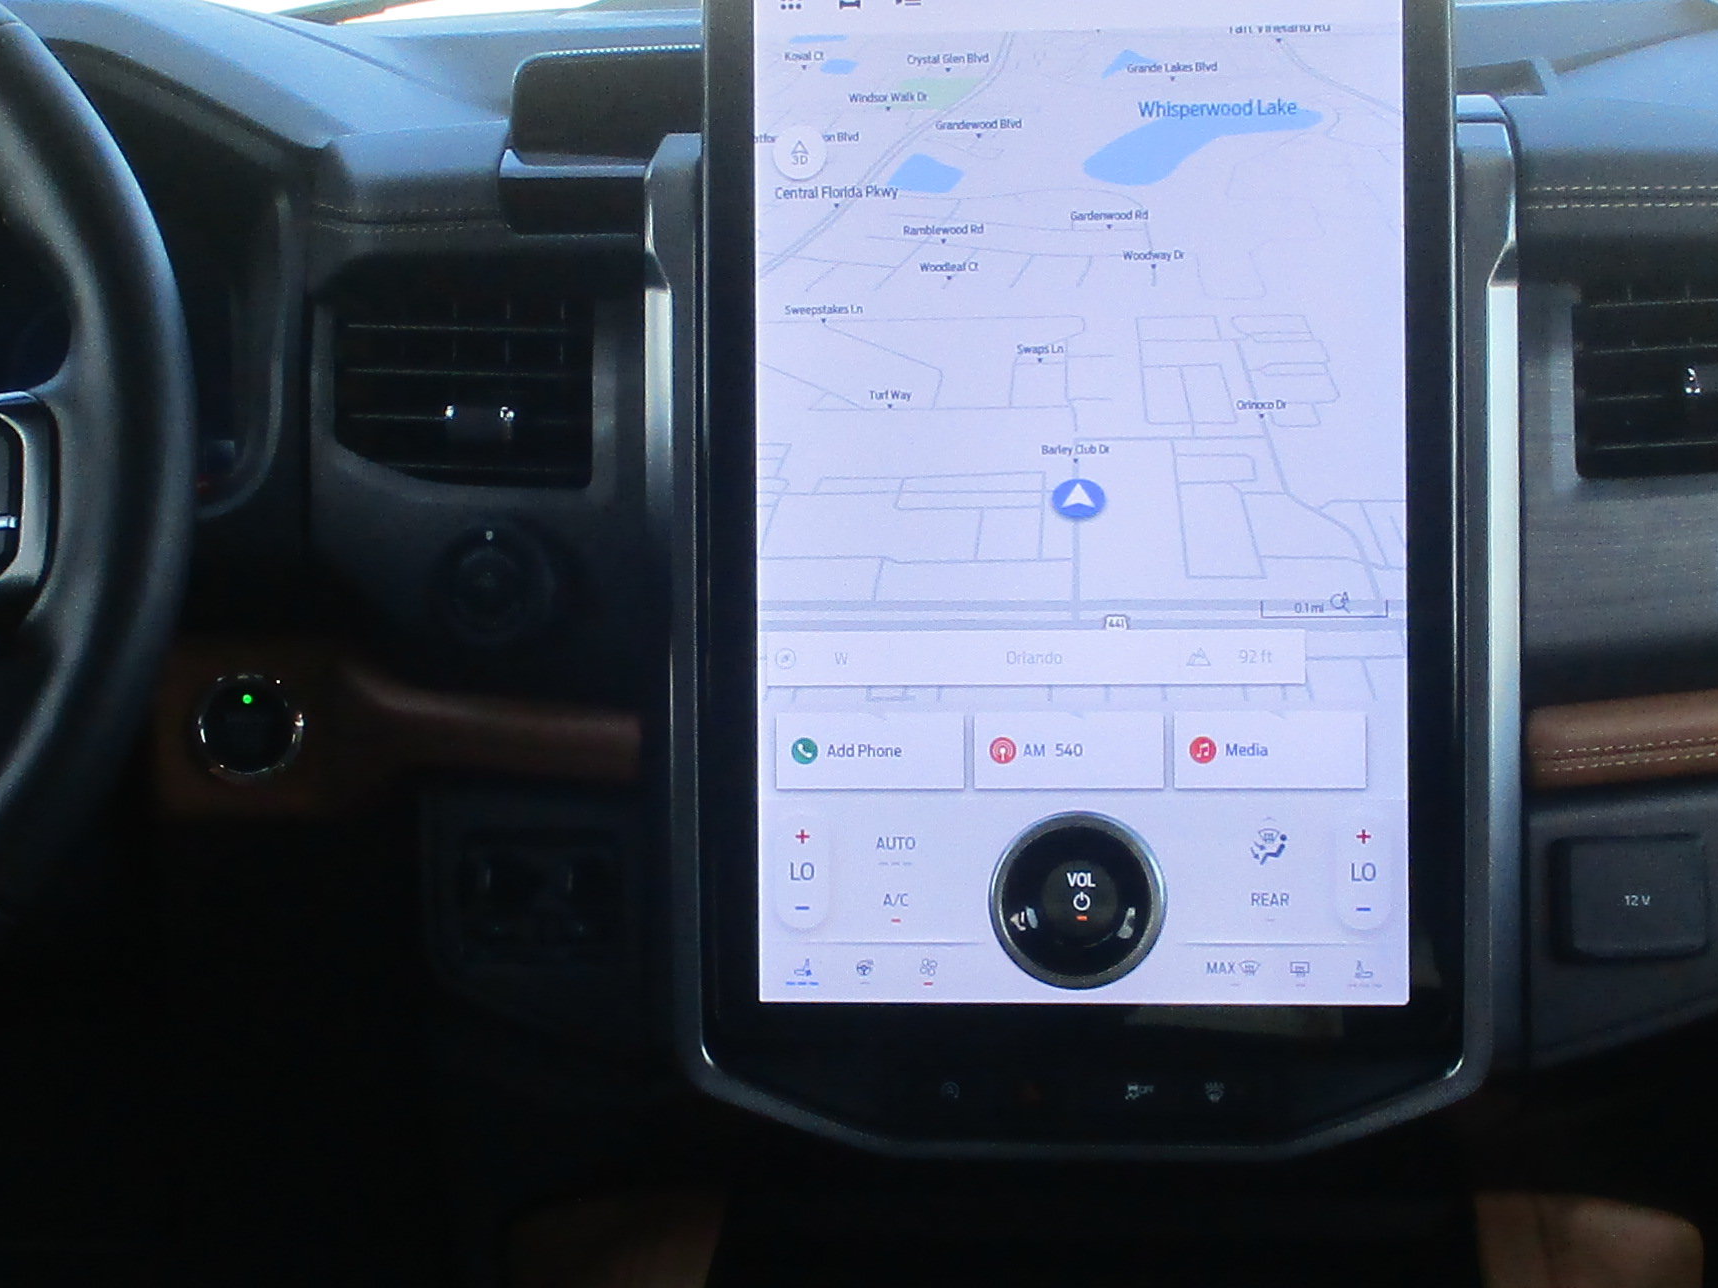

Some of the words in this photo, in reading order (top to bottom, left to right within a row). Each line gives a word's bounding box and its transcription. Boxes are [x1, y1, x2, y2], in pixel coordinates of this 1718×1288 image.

[810, 50, 824, 60] Ct
[906, 54, 940, 65] Crystal
[942, 53, 965, 64] Glen
[967, 52, 990, 63] Blvd
[1126, 62, 1163, 73] Grande
[1164, 62, 1193, 73] Lakes
[1195, 61, 1218, 72] Blvd
[848, 92, 888, 103] Windsor
[890, 91, 915, 103] Walk
[917, 91, 928, 102] Dr
[1138, 99, 1253, 119] Whisperwood
[1257, 98, 1297, 116] Lake
[935, 119, 997, 130] Grandewood
[1000, 118, 1022, 129] Blvd
[837, 131, 859, 142] Blvd
[791, 155, 808, 166] 3D
[774, 186, 819, 199] Central
[821, 185, 863, 199] Florida
[865, 184, 899, 200] Pkwy
[1070, 210, 1133, 221] Gardenwood
[1135, 210, 1149, 220] Rd
[903, 225, 968, 236] Ramblewood
[970, 224, 984, 234] Rd
[1122, 249, 1172, 262] Woodway
[1174, 249, 1184, 260] Dr
[920, 262, 966, 273] Woodleaf
[968, 261, 979, 272] Ct
[784, 304, 849, 316] Sweepstakes
[851, 304, 864, 314] Ln
[1016, 344, 1049, 356] Swaps
[1051, 344, 1064, 354] Ln
[869, 389, 889, 400] Turf
[890, 389, 912, 402] Way
[1236, 400, 1273, 410] Orinoco
[1275, 400, 1287, 410] Dr
[1041, 444, 1072, 456] Barley
[1075, 444, 1096, 455] Club
[1098, 444, 1110, 455] Dr
[1107, 618, 1125, 629] 441
[834, 652, 848, 665] W
[1005, 650, 1063, 665] Orlando
[1238, 649, 1258, 664] 92
[1260, 649, 1273, 664] ft
[826, 743, 855, 758] Add
[857, 743, 902, 758] Phone
[1022, 743, 1046, 757] AM
[1054, 743, 1083, 757] 540
[1225, 743, 1269, 757] Media
[876, 836, 916, 851] AUTO
[789, 861, 815, 882] LO
[1351, 861, 1377, 882] LO
[1066, 872, 1096, 888] VOL
[883, 892, 910, 908] A/C
[1250, 892, 1290, 907] REAR
[1205, 962, 1235, 975] MAX
